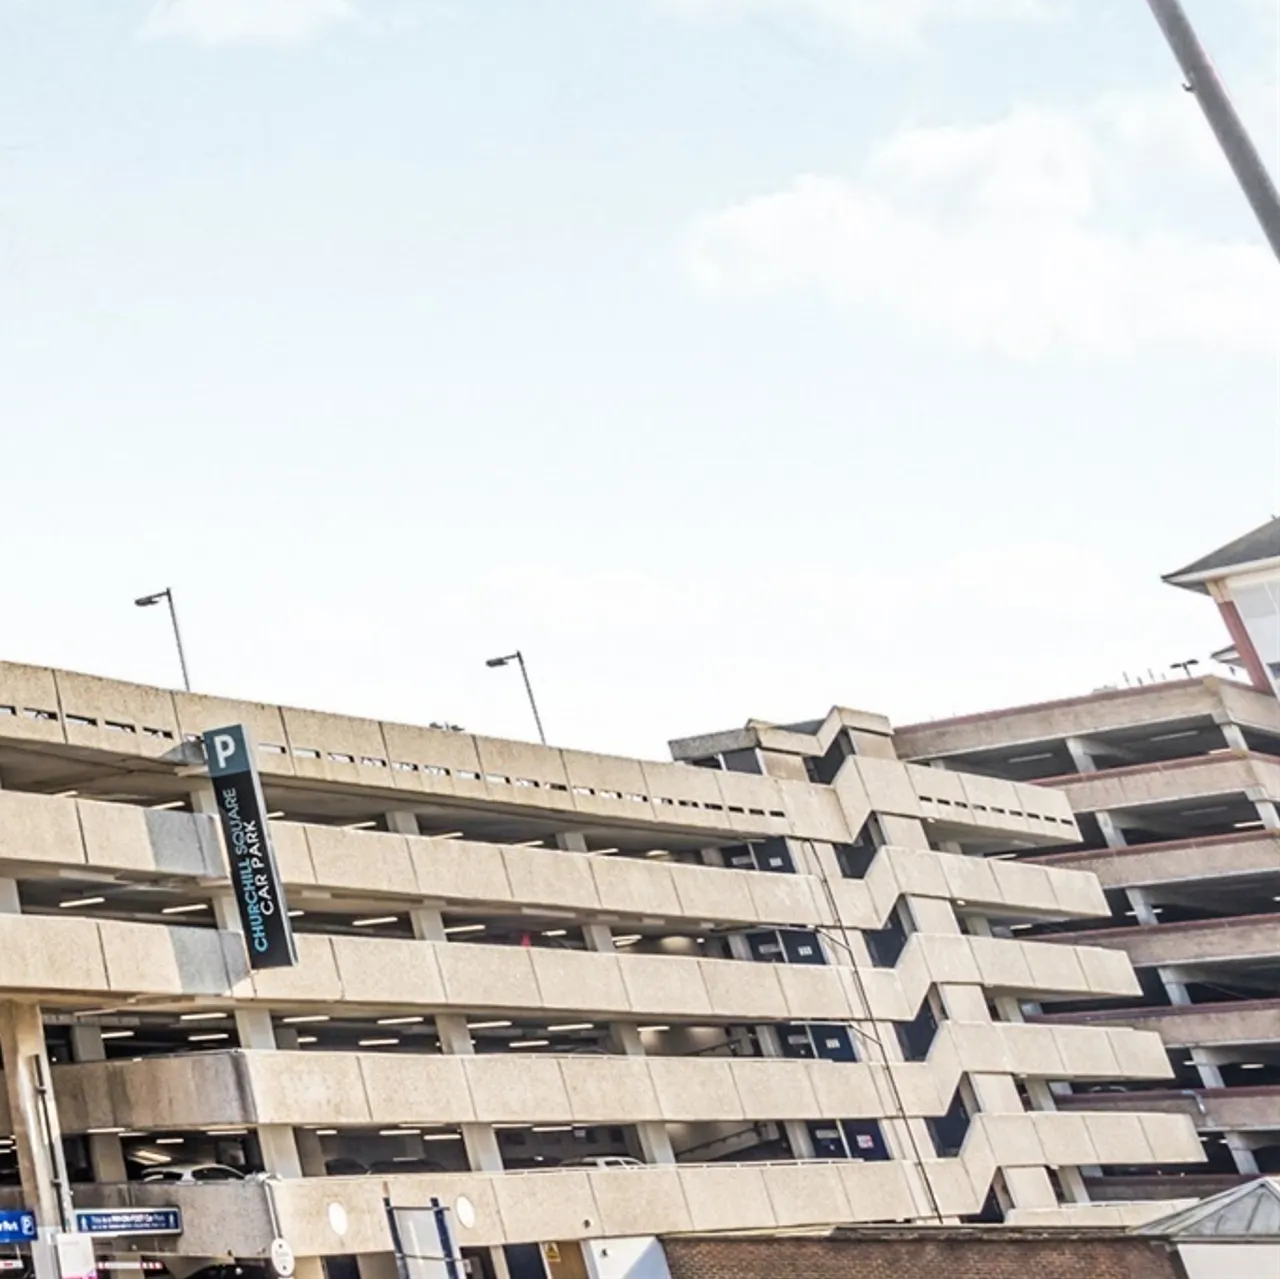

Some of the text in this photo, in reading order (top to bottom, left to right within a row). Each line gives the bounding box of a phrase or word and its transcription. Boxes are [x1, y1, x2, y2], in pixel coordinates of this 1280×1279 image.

[213, 734, 235, 768] P
[222, 787, 268, 953] CHURCHILL SQUARE
[243, 820, 274, 916] CAR PARK
[2, 1220, 19, 1231] Park
